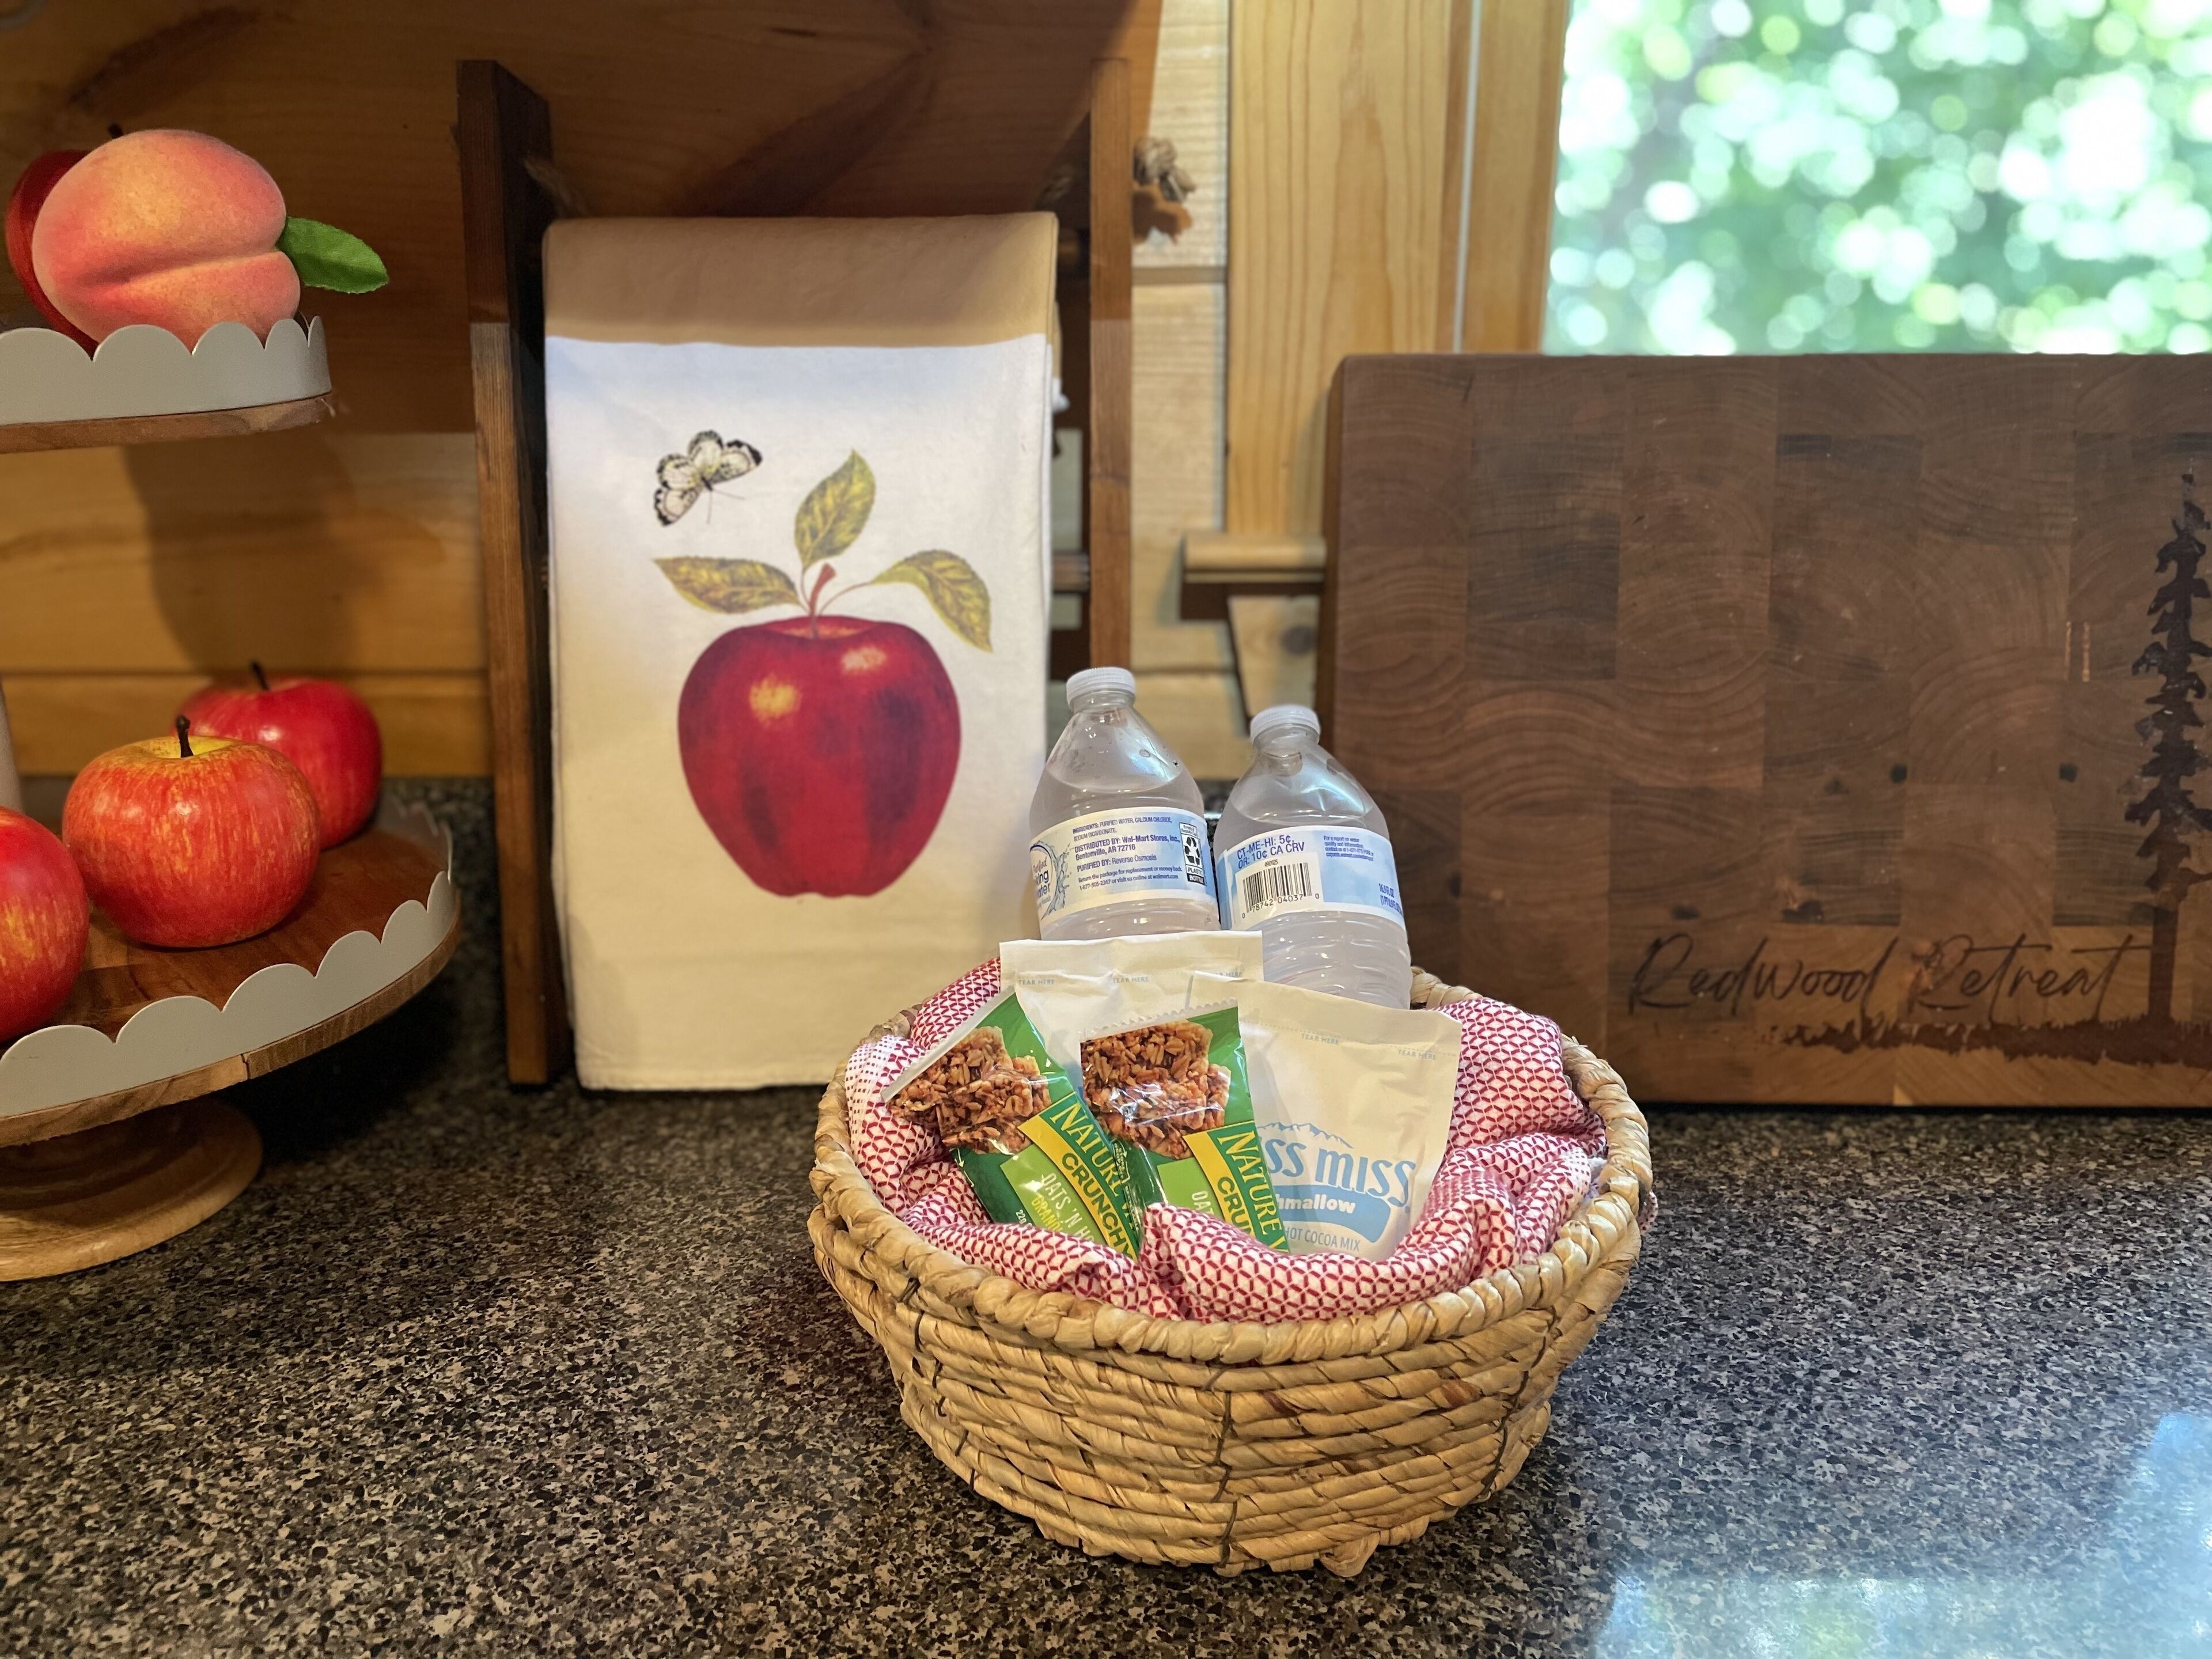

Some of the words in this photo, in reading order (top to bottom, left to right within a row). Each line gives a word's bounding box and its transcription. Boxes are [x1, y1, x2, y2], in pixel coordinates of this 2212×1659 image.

[1100, 819, 1118, 828] PURIFIED
[1074, 839, 1111, 853] DISTRIBUTED
[1111, 837, 1121, 845] BY:
[1122, 835, 1150, 843] Wal-Mart
[1150, 834, 1169, 843] Stores,
[1075, 848, 1108, 861] Bentonville,
[1108, 846, 1117, 854] AR
[1118, 843, 1136, 852] 72716
[1237, 837, 1277, 860] CT-ME-HI:
[1077, 860, 1101, 873] PURIFIED
[1101, 859, 1111, 867] BY:
[1112, 856, 1134, 865] Reverse
[1134, 854, 1157, 862] Osmosis
[1238, 856, 1250, 869] OR:
[1252, 850, 1268, 861] 10¢
[1270, 845, 1283, 856] CA
[1286, 842, 1305, 853] CRV
[1100, 871, 1118, 879] package
[1188, 867, 1202, 876] PLASTIC
[1189, 874, 1204, 883] BOTTLE
[1251, 899, 1274, 913] 78742
[1277, 894, 1304, 904] 04037
[1628, 933, 1900, 1021] Redwood
[1908, 933, 2151, 1021] Retreat
[1301, 1033, 1320, 1041] TEAR
[1321, 1037, 1340, 1045] HERE
[1397, 1049, 1416, 1058] TEAR
[1418, 1052, 1437, 1060] HERE
[1041, 1173, 1071, 1210] OATS
[1217, 1130, 1282, 1235] NATURE
[1062, 1153, 1132, 1257] CRUNCHY
[1304, 1229, 1338, 1248] COCOA
[1340, 1237, 1361, 1252] MIX
